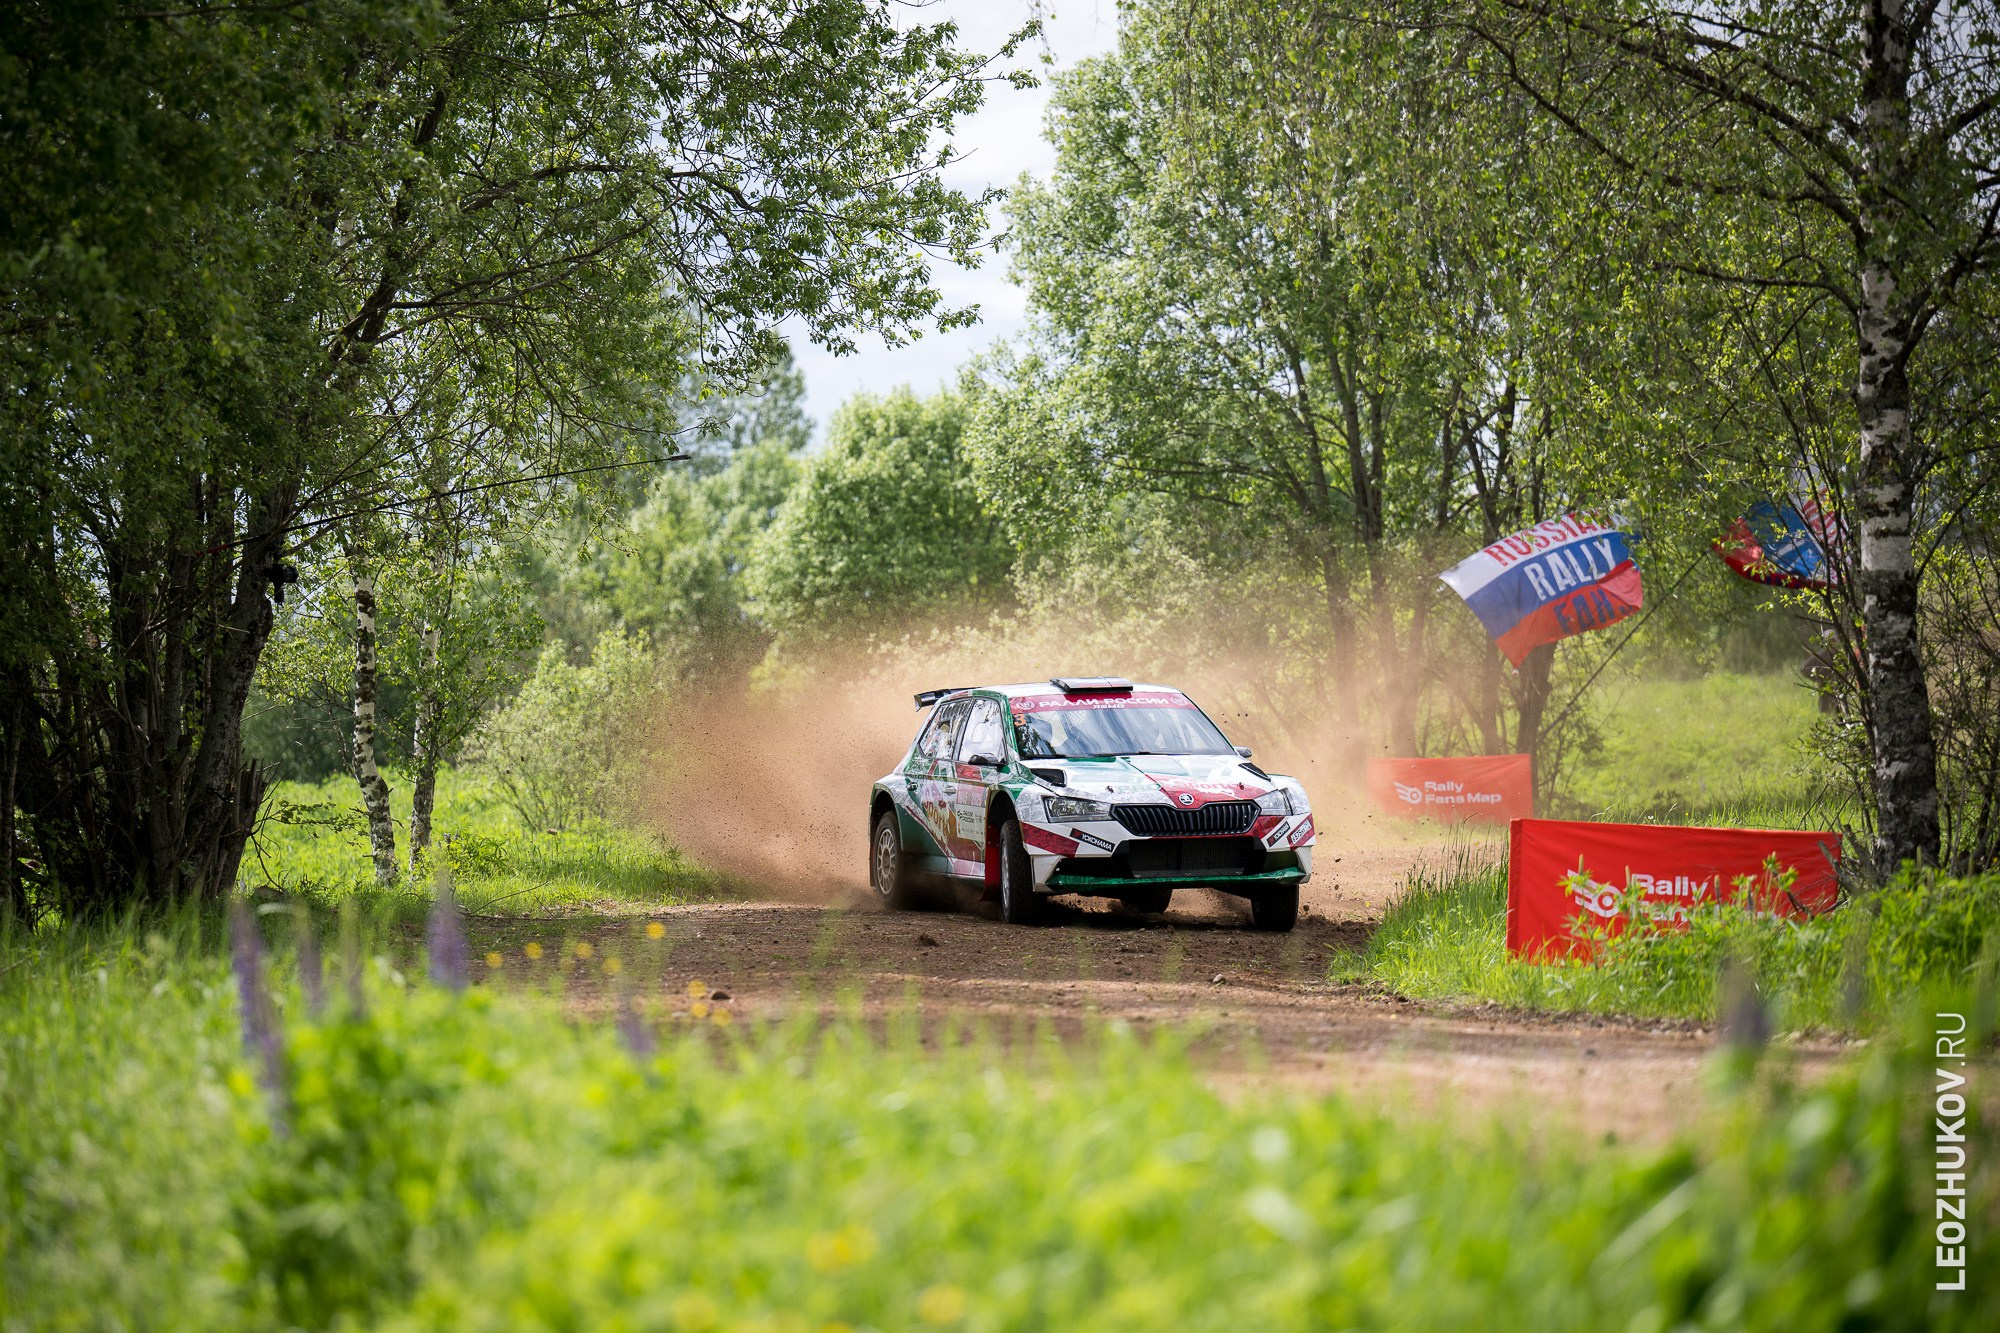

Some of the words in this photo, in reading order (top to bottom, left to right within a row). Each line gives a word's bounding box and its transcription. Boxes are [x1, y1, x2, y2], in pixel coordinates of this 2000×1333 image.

[1523, 538, 1616, 601] RALLY
[1014, 713, 1027, 727] 3
[1424, 780, 1464, 793] Rally
[1425, 794, 1465, 804] Fans
[1467, 793, 1502, 805] Map
[1081, 833, 1112, 850] YOKOHAMA
[1631, 873, 1708, 901] Rally
